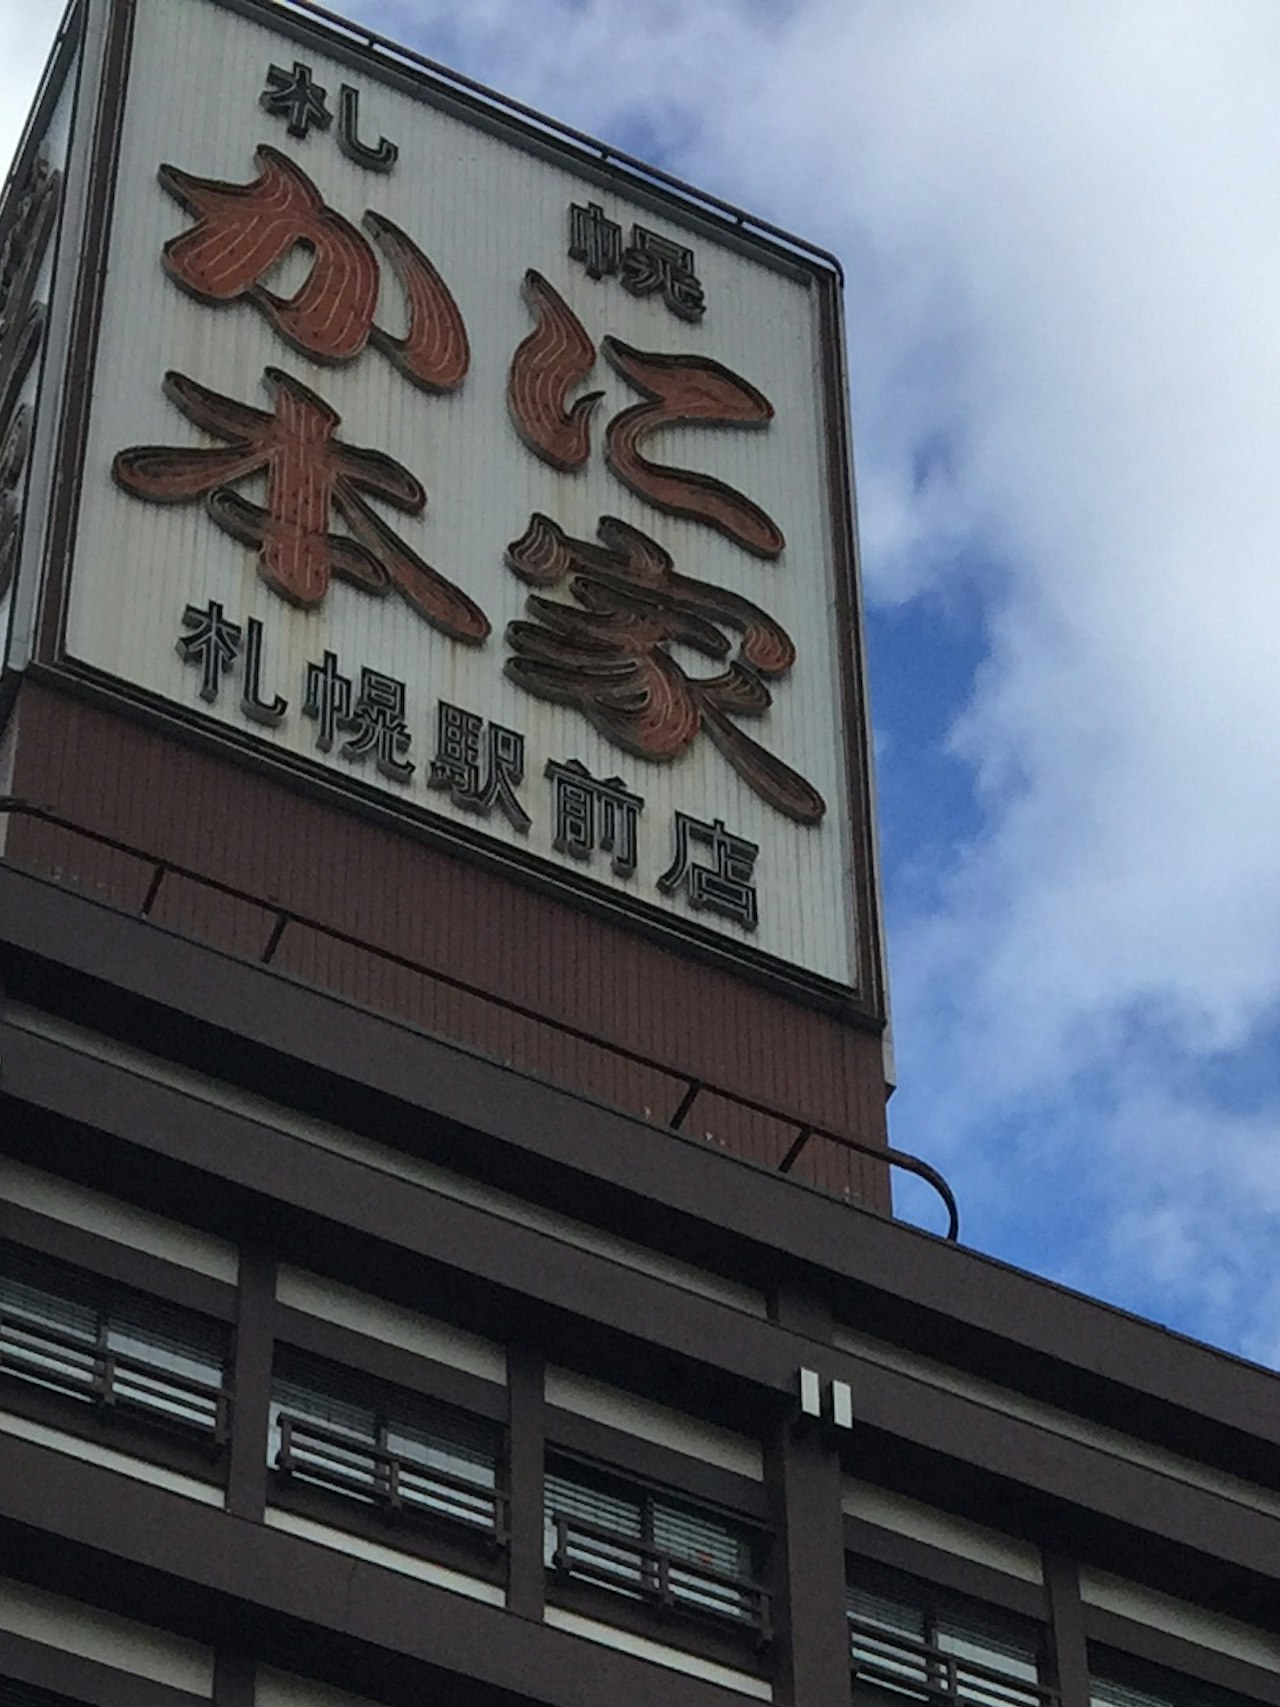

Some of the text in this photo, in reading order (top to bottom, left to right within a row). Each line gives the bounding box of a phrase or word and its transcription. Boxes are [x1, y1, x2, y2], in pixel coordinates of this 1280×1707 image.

[159, 144, 786, 561] かに
[112, 368, 826, 826] 本家
[178, 601, 760, 928] 札幌駅前店
